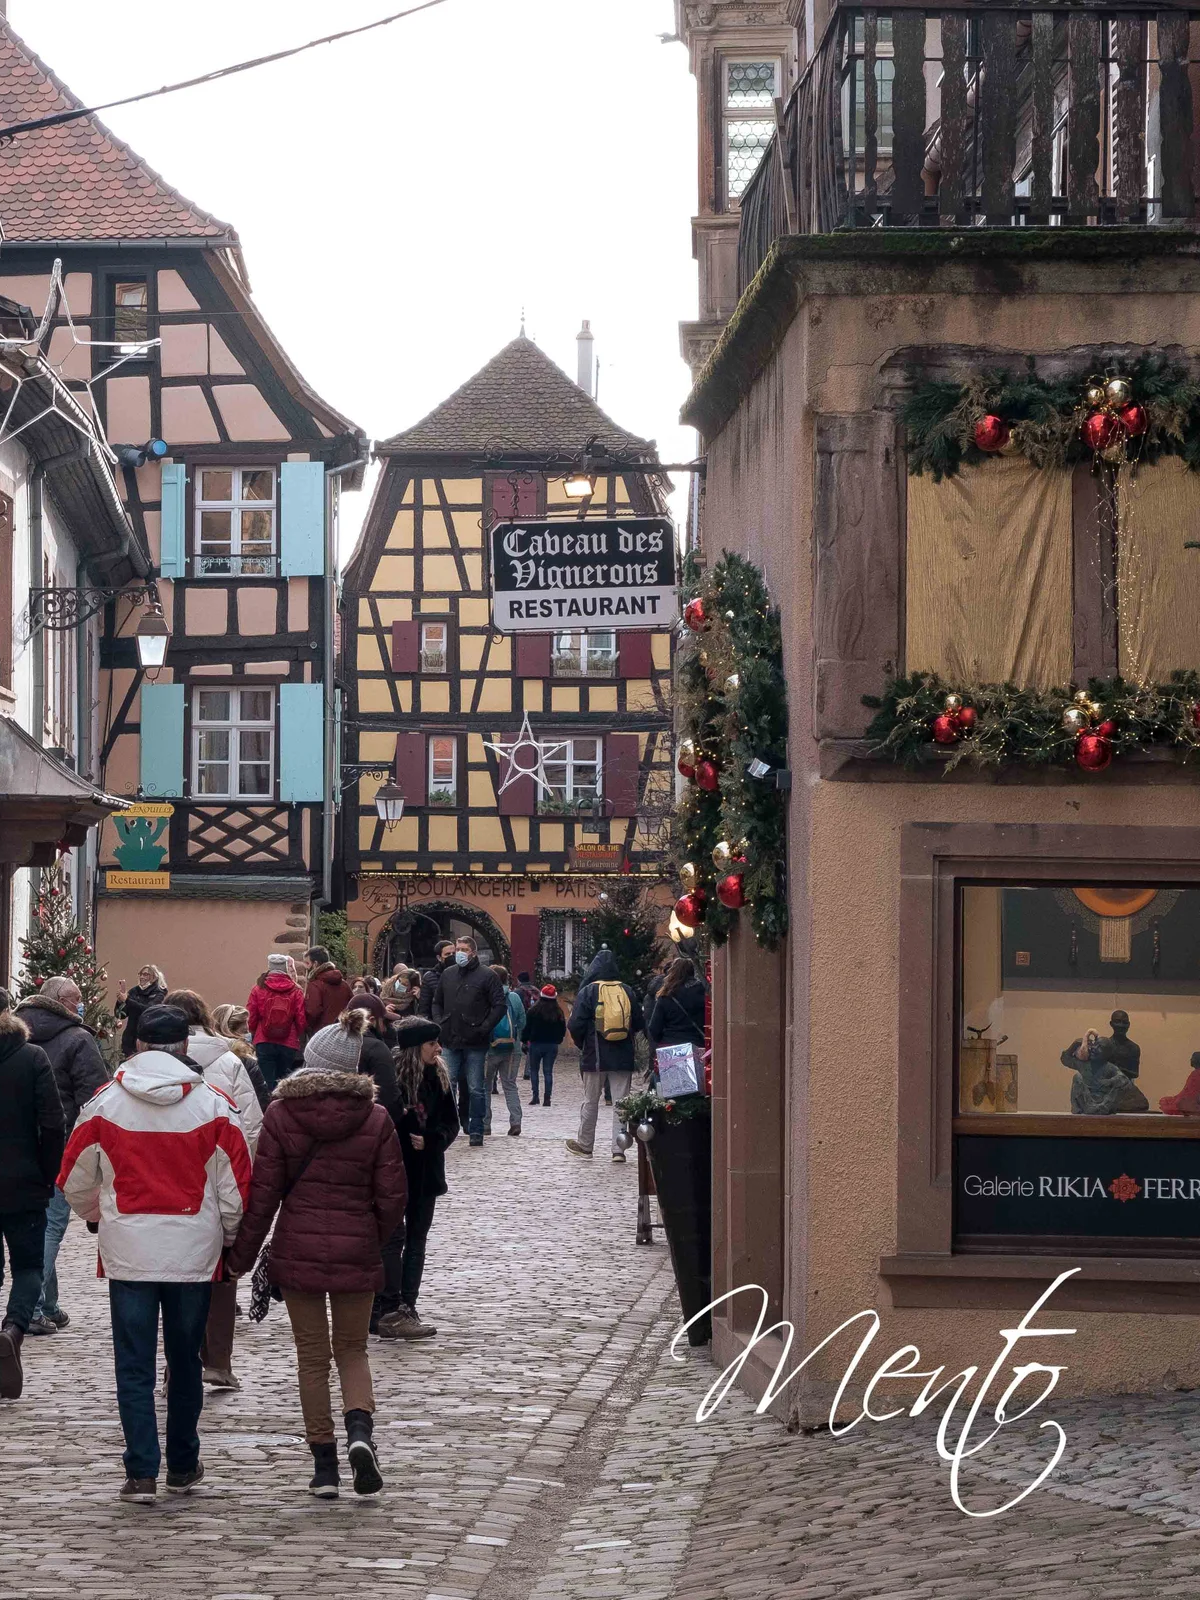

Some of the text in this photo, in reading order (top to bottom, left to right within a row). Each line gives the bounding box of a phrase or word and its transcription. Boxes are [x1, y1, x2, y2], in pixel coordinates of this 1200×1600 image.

[503, 526, 664, 558] Caveau des
[509, 558, 659, 590] Vignerons
[509, 595, 661, 619] RESTAURANT
[575, 844, 596, 852] SALON
[109, 874, 165, 886] Restaurant
[406, 879, 526, 897] BOULANGERIE
[963, 1174, 1034, 1197] Galerie
[1038, 1176, 1108, 1198] RIKIA
